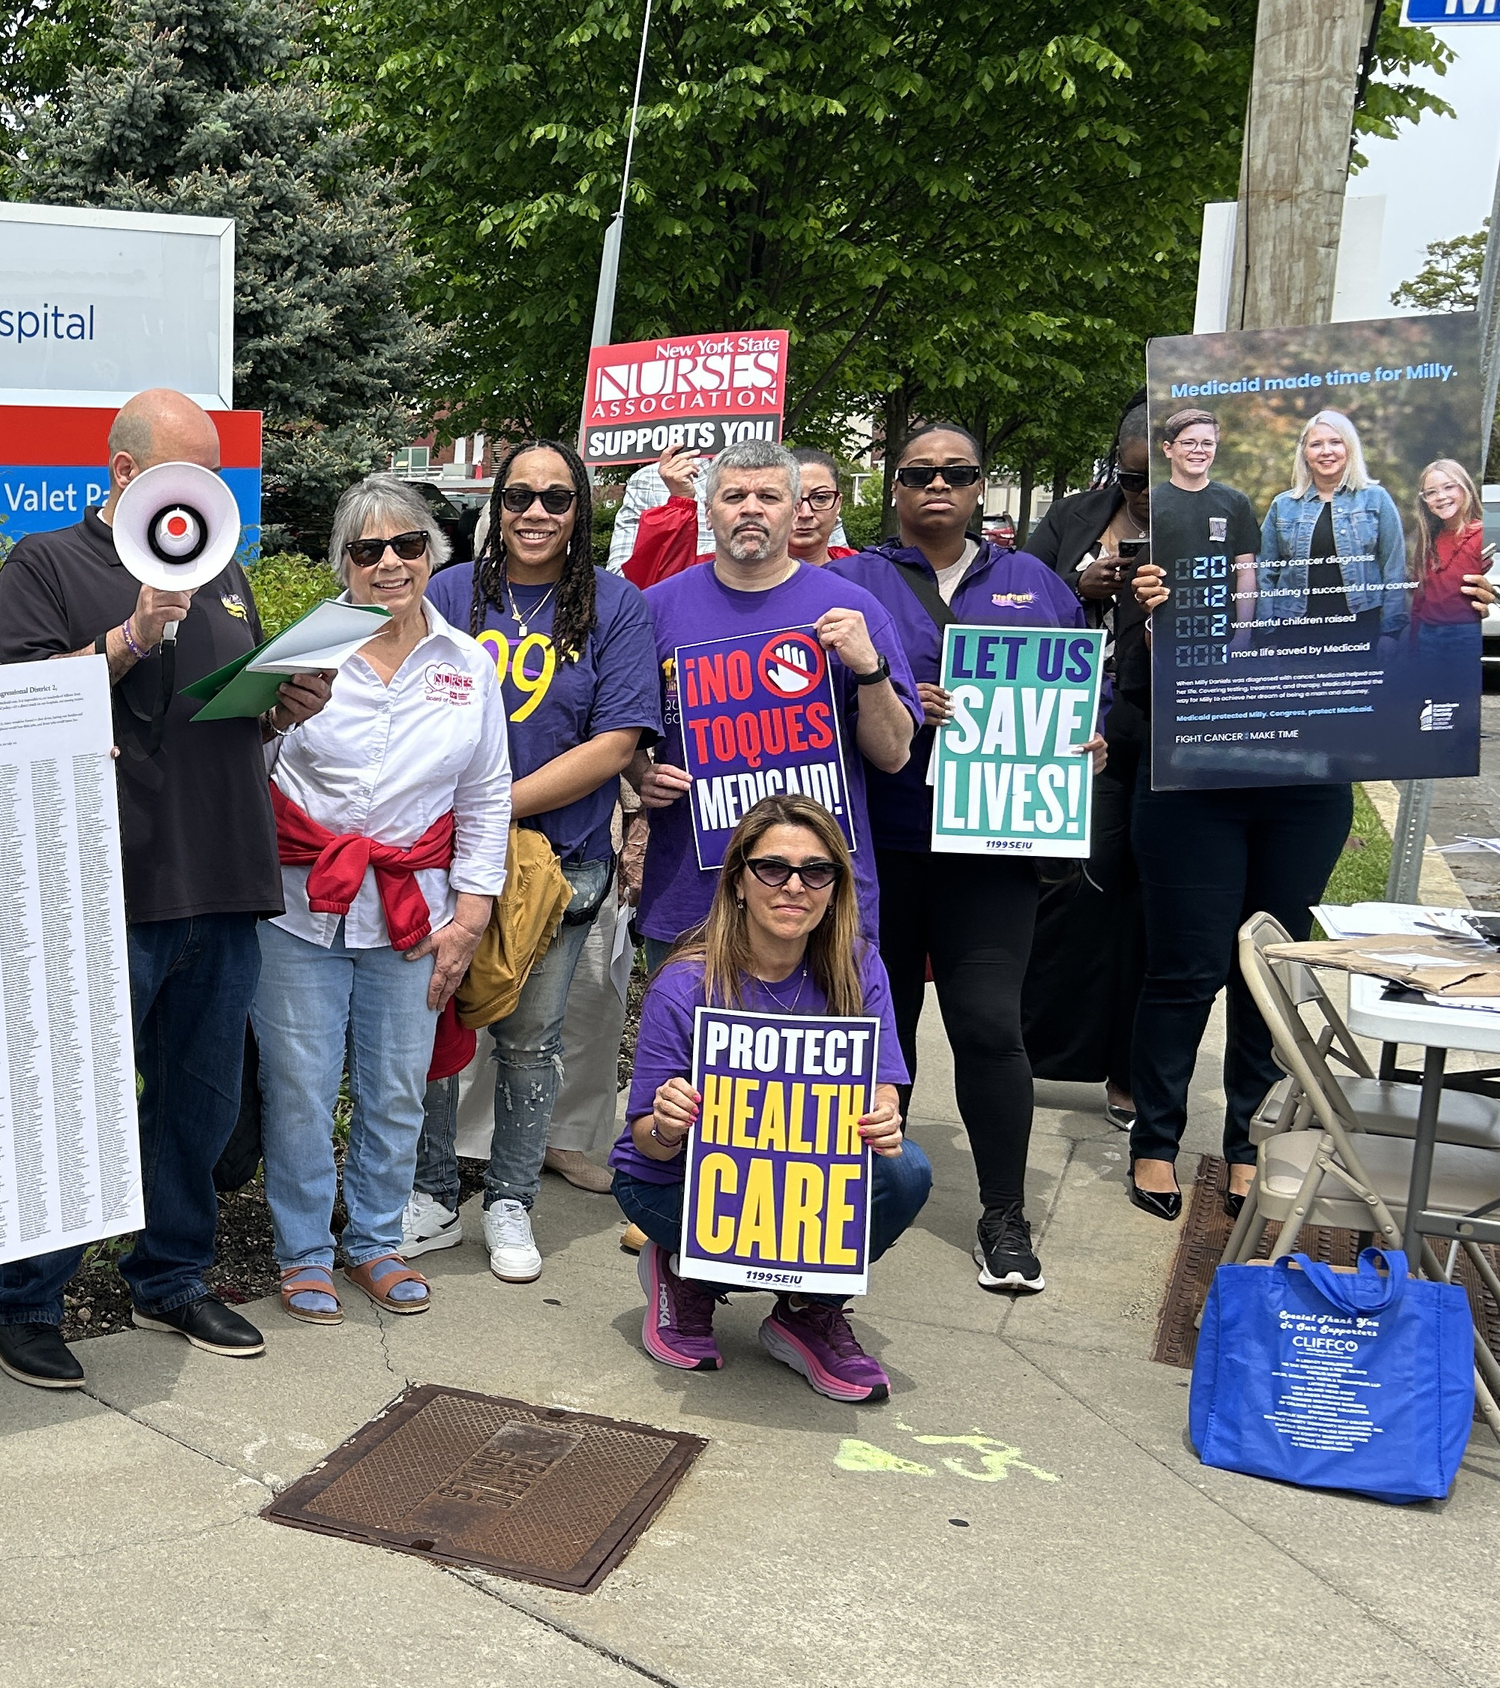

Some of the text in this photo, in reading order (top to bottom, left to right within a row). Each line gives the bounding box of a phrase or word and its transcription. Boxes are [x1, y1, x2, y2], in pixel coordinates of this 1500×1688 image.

[656, 337, 779, 359] New York State
[595, 352, 779, 401] NURSES
[1171, 363, 1458, 398] Medicaid made time for Milly.
[592, 390, 777, 418] ASSOCIATION
[589, 420, 774, 456] SUPPORTS YOU
[4, 482, 77, 511] Valet
[1231, 560, 1258, 572] years
[1260, 558, 1286, 569] since
[1288, 557, 1324, 568] cancer
[1326, 553, 1375, 565] diagnosis
[1231, 588, 1258, 601] years
[1260, 586, 1300, 600] building
[1303, 588, 1310, 596] a
[1312, 583, 1364, 596] successful
[1366, 581, 1385, 592] law
[1386, 580, 1420, 591] career
[1231, 616, 1281, 630] wonderful
[1282, 615, 1323, 628] children
[1325, 613, 1356, 625] raised
[951, 636, 1094, 682] LET US
[1231, 648, 1258, 659] more
[1260, 647, 1275, 657] life
[1277, 645, 1307, 656] saved
[1308, 645, 1322, 657] by
[1324, 642, 1370, 654] Medicaid
[685, 650, 754, 708] ¡NO
[689, 702, 834, 767] TOQUES
[945, 685, 1088, 758] SAVE
[1176, 730, 1299, 743] FIGHT CANCER MAKE TIME
[942, 761, 1080, 834] LIVES!
[986, 840, 1033, 850] 1199SEIU
[705, 1020, 869, 1076] PROTECT
[701, 1074, 865, 1155] HEALTH
[696, 1152, 862, 1266] CARE
[745, 1270, 803, 1284] 1199SEIU
[657, 1282, 671, 1328] HOKA
[1279, 1310, 1380, 1328] Special Thank You
[1280, 1321, 1377, 1337] To Our Supporters
[1292, 1336, 1359, 1352] CLIFFCO
